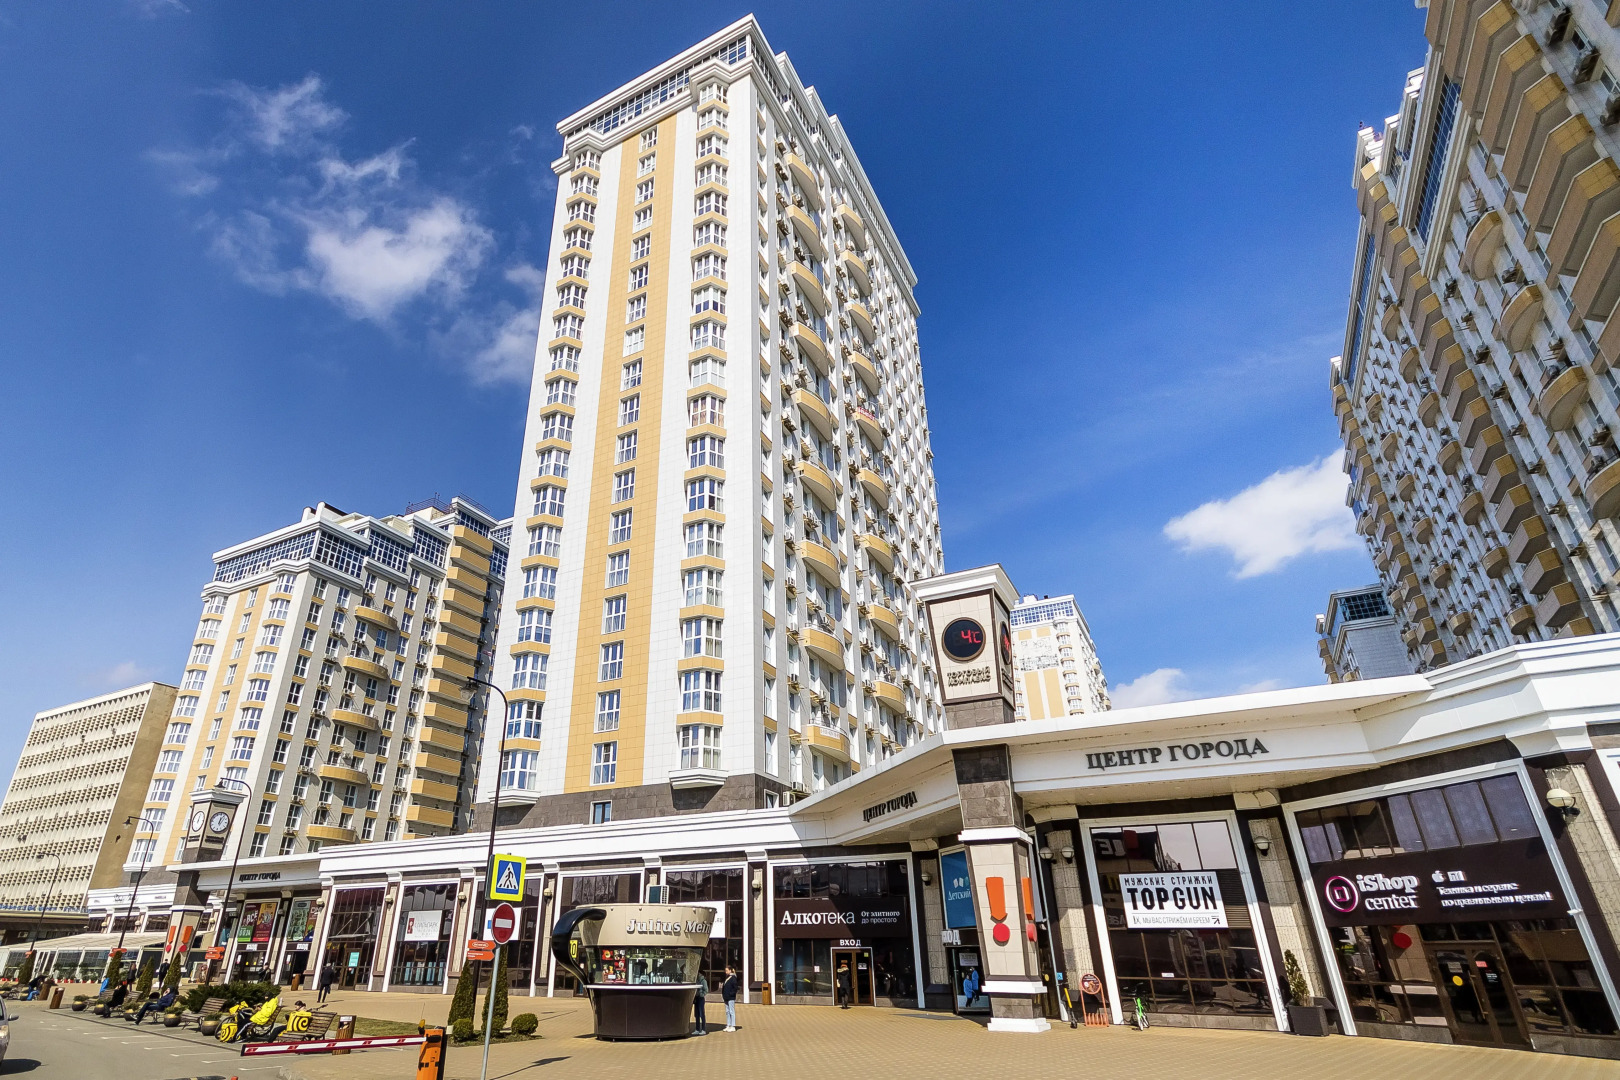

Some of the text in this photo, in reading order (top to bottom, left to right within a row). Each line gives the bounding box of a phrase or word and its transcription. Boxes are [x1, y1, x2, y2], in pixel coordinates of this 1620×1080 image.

[947, 666, 990, 680] ТОРГОВЫЙ
[948, 675, 991, 688] КОМПЛЕКС
[1086, 737, 1269, 771] ЦЕНТР ГОРОДА
[863, 791, 918, 823] ЦЕНТР ГОРОДА
[1124, 875, 1213, 886] МУЖСКИЕ СТРИЖКИ
[1356, 873, 1418, 893] iShop
[948, 888, 971, 901] Детский
[1365, 894, 1418, 911] center
[780, 910, 855, 925] Алкотека
[627, 919, 681, 935] Julius
